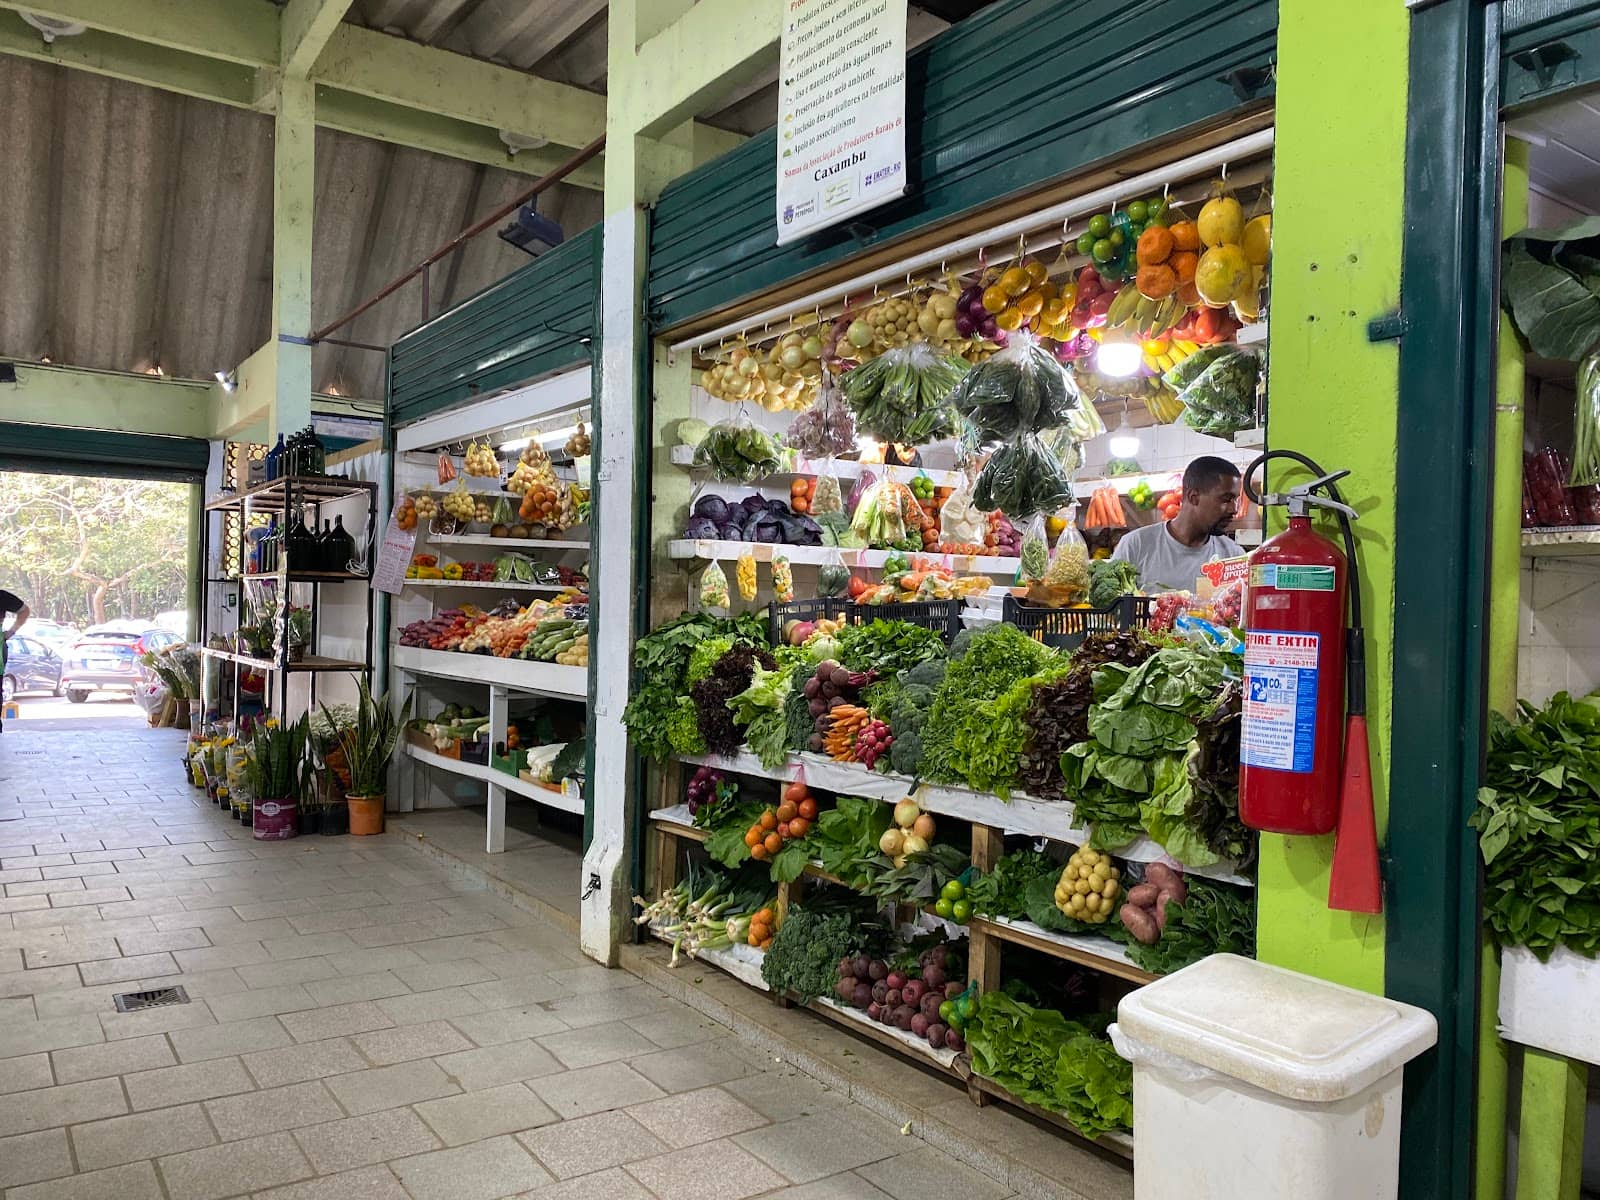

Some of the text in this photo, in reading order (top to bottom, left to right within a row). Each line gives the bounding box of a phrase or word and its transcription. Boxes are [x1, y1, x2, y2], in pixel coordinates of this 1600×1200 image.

[796, 0, 887, 63] Fortalecimento da economia local
[818, 57, 826, 67] ao
[826, 46, 846, 66] plantio
[846, 26, 879, 51] consciente
[842, 60, 852, 72] das
[871, 39, 893, 58] limpas
[795, 93, 825, 118] Preservação
[826, 89, 834, 101] do
[848, 67, 876, 87] ambiente
[816, 111, 826, 124] dos
[861, 90, 869, 101] na
[814, 151, 866, 181] Caxambu
[1277, 636, 1317, 647] EXTIN
